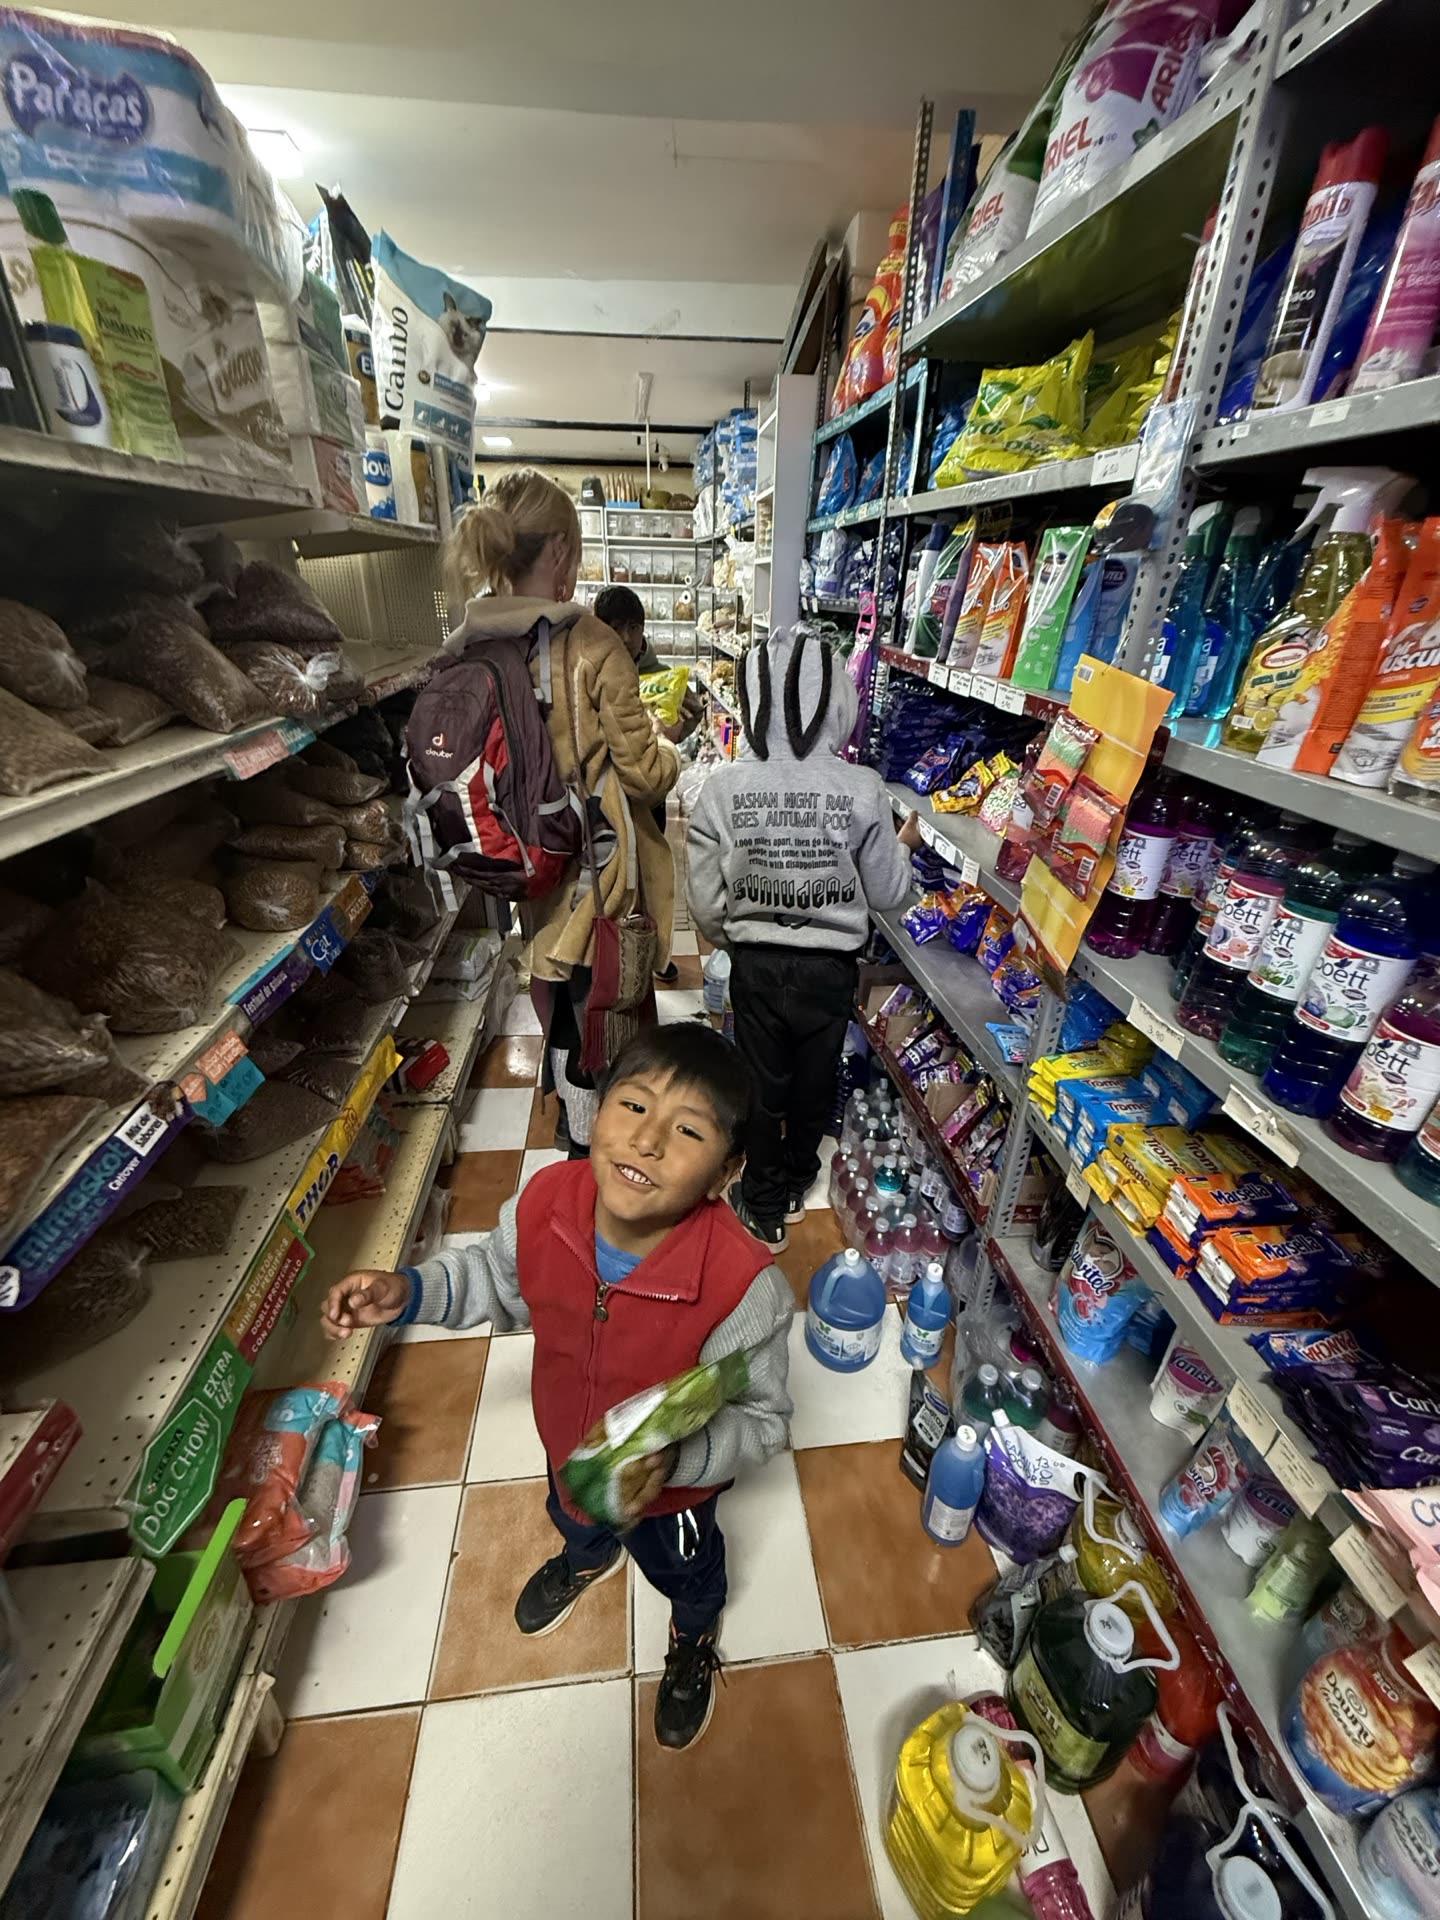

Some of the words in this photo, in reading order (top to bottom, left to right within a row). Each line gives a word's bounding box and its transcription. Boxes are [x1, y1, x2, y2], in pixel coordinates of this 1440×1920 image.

[9, 61, 143, 128] Paracas
[384, 306, 409, 411] Canbo
[425, 747, 454, 759] deuter
[732, 791, 779, 811] BASHAN
[783, 792, 820, 809] NIGHT
[825, 794, 854, 812] RAIN
[765, 811, 817, 828] AUTUMN
[794, 838, 811, 847] then
[785, 859, 839, 870] disappointment
[310, 934, 332, 961] Cat
[125, 1122, 142, 1141] Mix
[134, 1119, 163, 1149] Sabores
[1146, 1136, 1187, 1176] Trome
[1185, 1136, 1219, 1174] Trom
[15, 1140, 132, 1270] mimaskot
[295, 1152, 340, 1225] THOR
[1209, 1183, 1274, 1207] Marsella
[1256, 1234, 1324, 1262] Marsella
[244, 1250, 275, 1302] ADULTOS
[1068, 1241, 1116, 1295] Suavitel
[236, 1307, 258, 1336] MINIS
[250, 1303, 271, 1336] DOBLE
[251, 1330, 268, 1354] CON
[266, 1297, 285, 1330] CARNE
[284, 1258, 303, 1294] POLLO
[203, 1350, 233, 1399] EXTRA
[213, 1373, 236, 1410] life
[140, 1482, 179, 1538] DOG
[170, 1413, 212, 1481] CHOW
[1326, 1671, 1376, 1749] Downy
